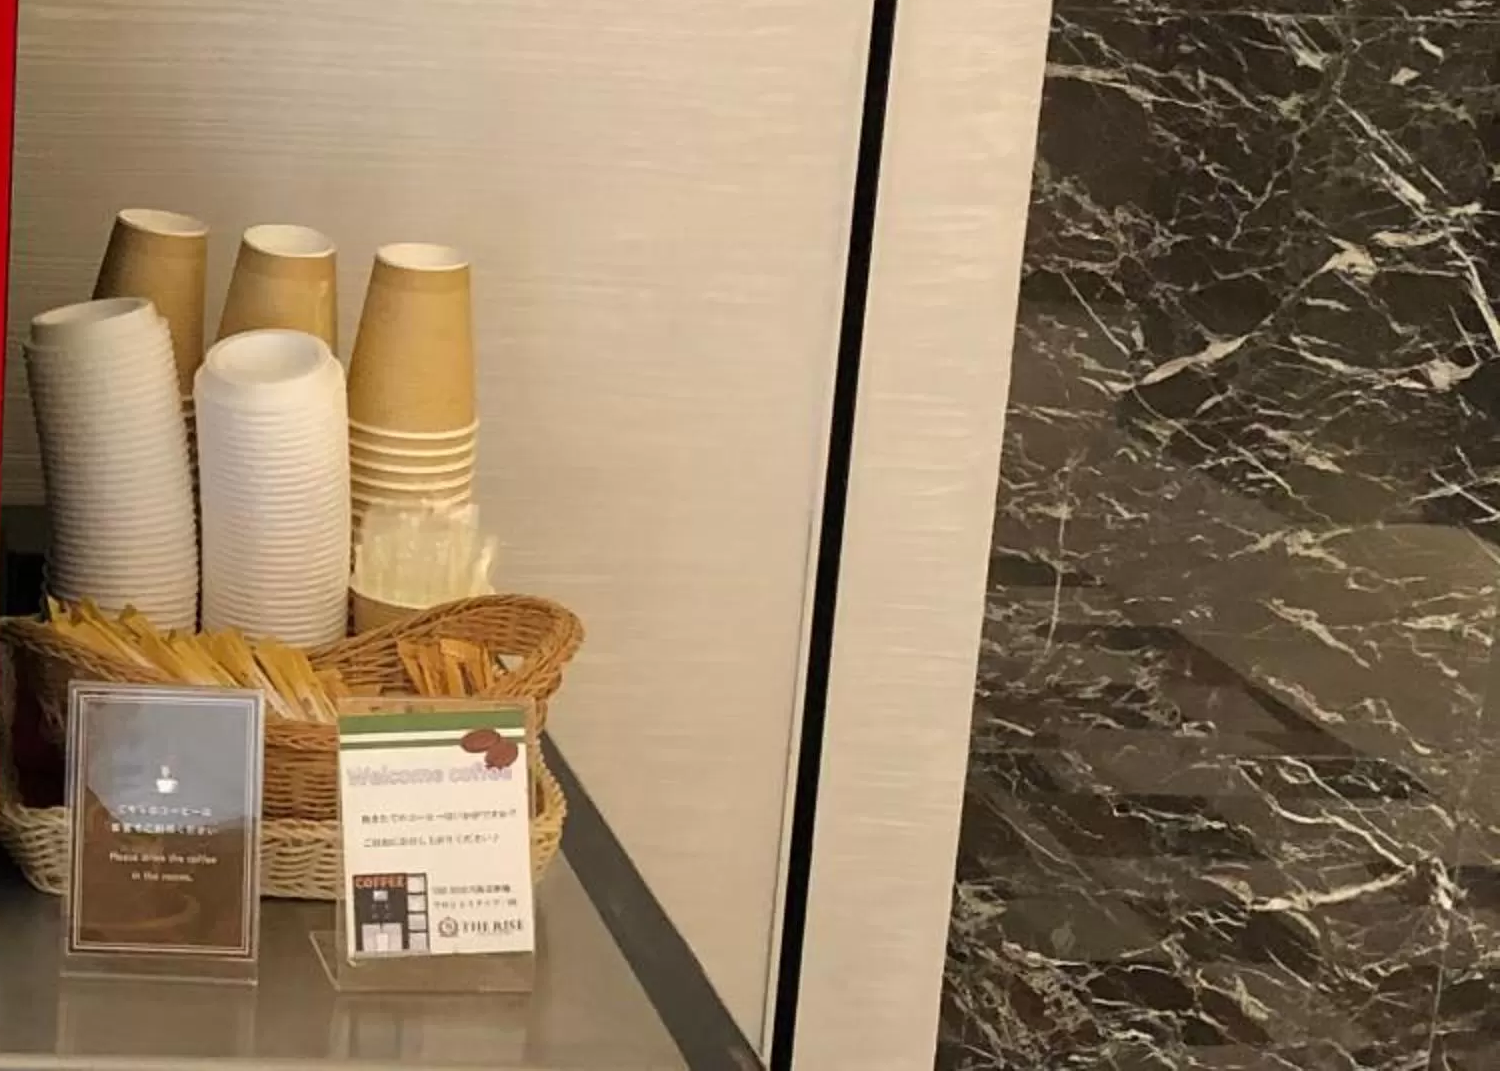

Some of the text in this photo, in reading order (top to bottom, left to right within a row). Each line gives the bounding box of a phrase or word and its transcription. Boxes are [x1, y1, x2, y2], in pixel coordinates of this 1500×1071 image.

[347, 764, 444, 786] Welcome
[186, 854, 217, 865] coffee
[355, 875, 405, 889] COFFEE
